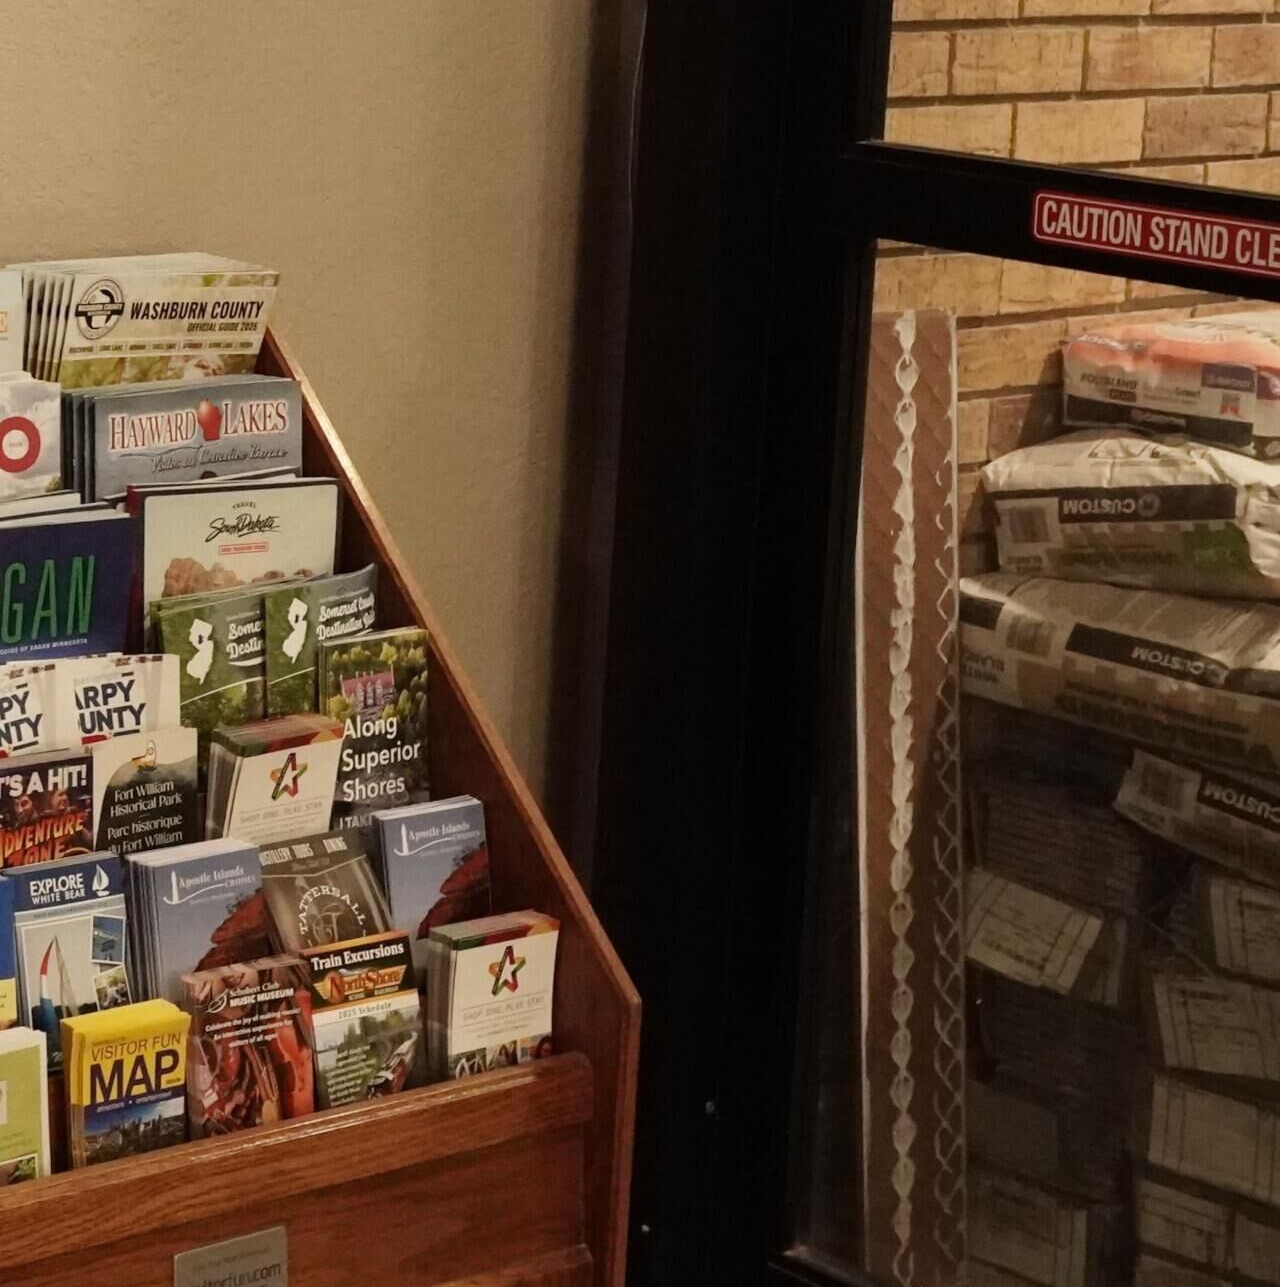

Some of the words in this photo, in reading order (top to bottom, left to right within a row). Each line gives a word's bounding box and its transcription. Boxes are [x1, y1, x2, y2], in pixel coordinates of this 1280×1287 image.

[1042, 200, 1141, 247] CAUTION
[1149, 217, 1227, 260] STAND
[130, 302, 208, 320] WASHBURN
[209, 301, 264, 319] COUNTY
[187, 322, 217, 332] OFFICIAL
[218, 322, 239, 331] GUIDE
[110, 411, 195, 449] HAYWARD
[223, 402, 287, 434] LAKES
[232, 500, 257, 509] TRAVEL
[1062, 497, 1135, 514] CUSTOM
[319, 599, 358, 621] Somerset
[0, 647, 18, 656] GUIDE
[20, 645, 28, 653] OF
[30, 642, 50, 651] EAGAN
[52, 638, 88, 648] MINNESOTA
[1131, 645, 1206, 674] CUSTOM
[342, 715, 398, 740] Along
[342, 740, 421, 774] Superior
[26, 771, 44, 795] A
[47, 764, 87, 791] HIT!
[114, 788, 134, 802] Fort
[136, 779, 174, 798] William
[342, 774, 405, 803] Shores
[110, 800, 157, 818] Historical
[159, 791, 182, 806] Park
[107, 823, 129, 840] Parc
[131, 815, 183, 835] historique
[409, 826, 439, 842] Apostle
[442, 821, 470, 835] Islands
[122, 839, 142, 853] Fort
[144, 830, 183, 848] William
[30, 873, 84, 896] EXPLORE
[178, 871, 211, 889] Apostle
[213, 866, 244, 882] Islands
[32, 893, 61, 905] WHITE
[65, 889, 85, 900] BEAR
[300, 885, 366, 934] TATTERSALL
[311, 954, 342, 971] Train
[344, 943, 404, 965] Excursions
[230, 986, 260, 998] Schubert
[262, 981, 280, 991] Club
[230, 995, 256, 1007] MUSIC
[257, 988, 294, 1002] MUSEUM
[359, 1002, 391, 1013] Schedule
[242, 1017, 251, 1026] joy
[252, 1014, 259, 1022] of
[92, 1039, 148, 1061] VISITOR
[153, 1032, 181, 1049] FUN
[90, 1049, 179, 1105] MAP
